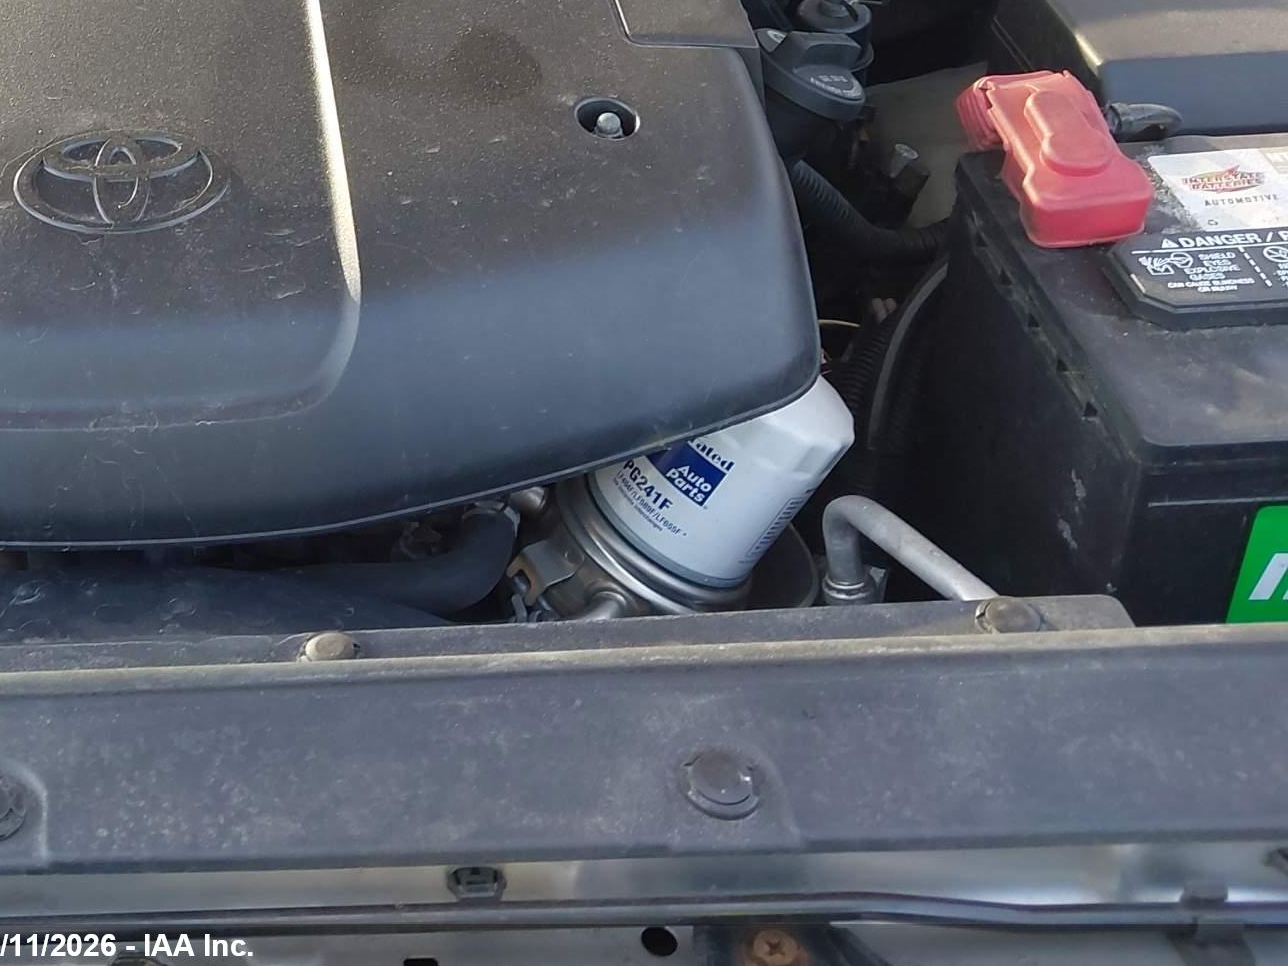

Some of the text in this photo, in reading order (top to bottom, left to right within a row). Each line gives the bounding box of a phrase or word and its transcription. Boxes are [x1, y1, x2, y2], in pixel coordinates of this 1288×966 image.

[1181, 171, 1265, 185] INTERSTATE
[1191, 177, 1265, 191] BATTERIES
[1204, 193, 1281, 207] AUTOMOTIVE
[1178, 233, 1262, 248] DANGER
[1198, 251, 1236, 261] SHIELD
[623, 459, 674, 511] PG241F
[666, 467, 706, 504] Parts
[677, 464, 712, 493] Auto
